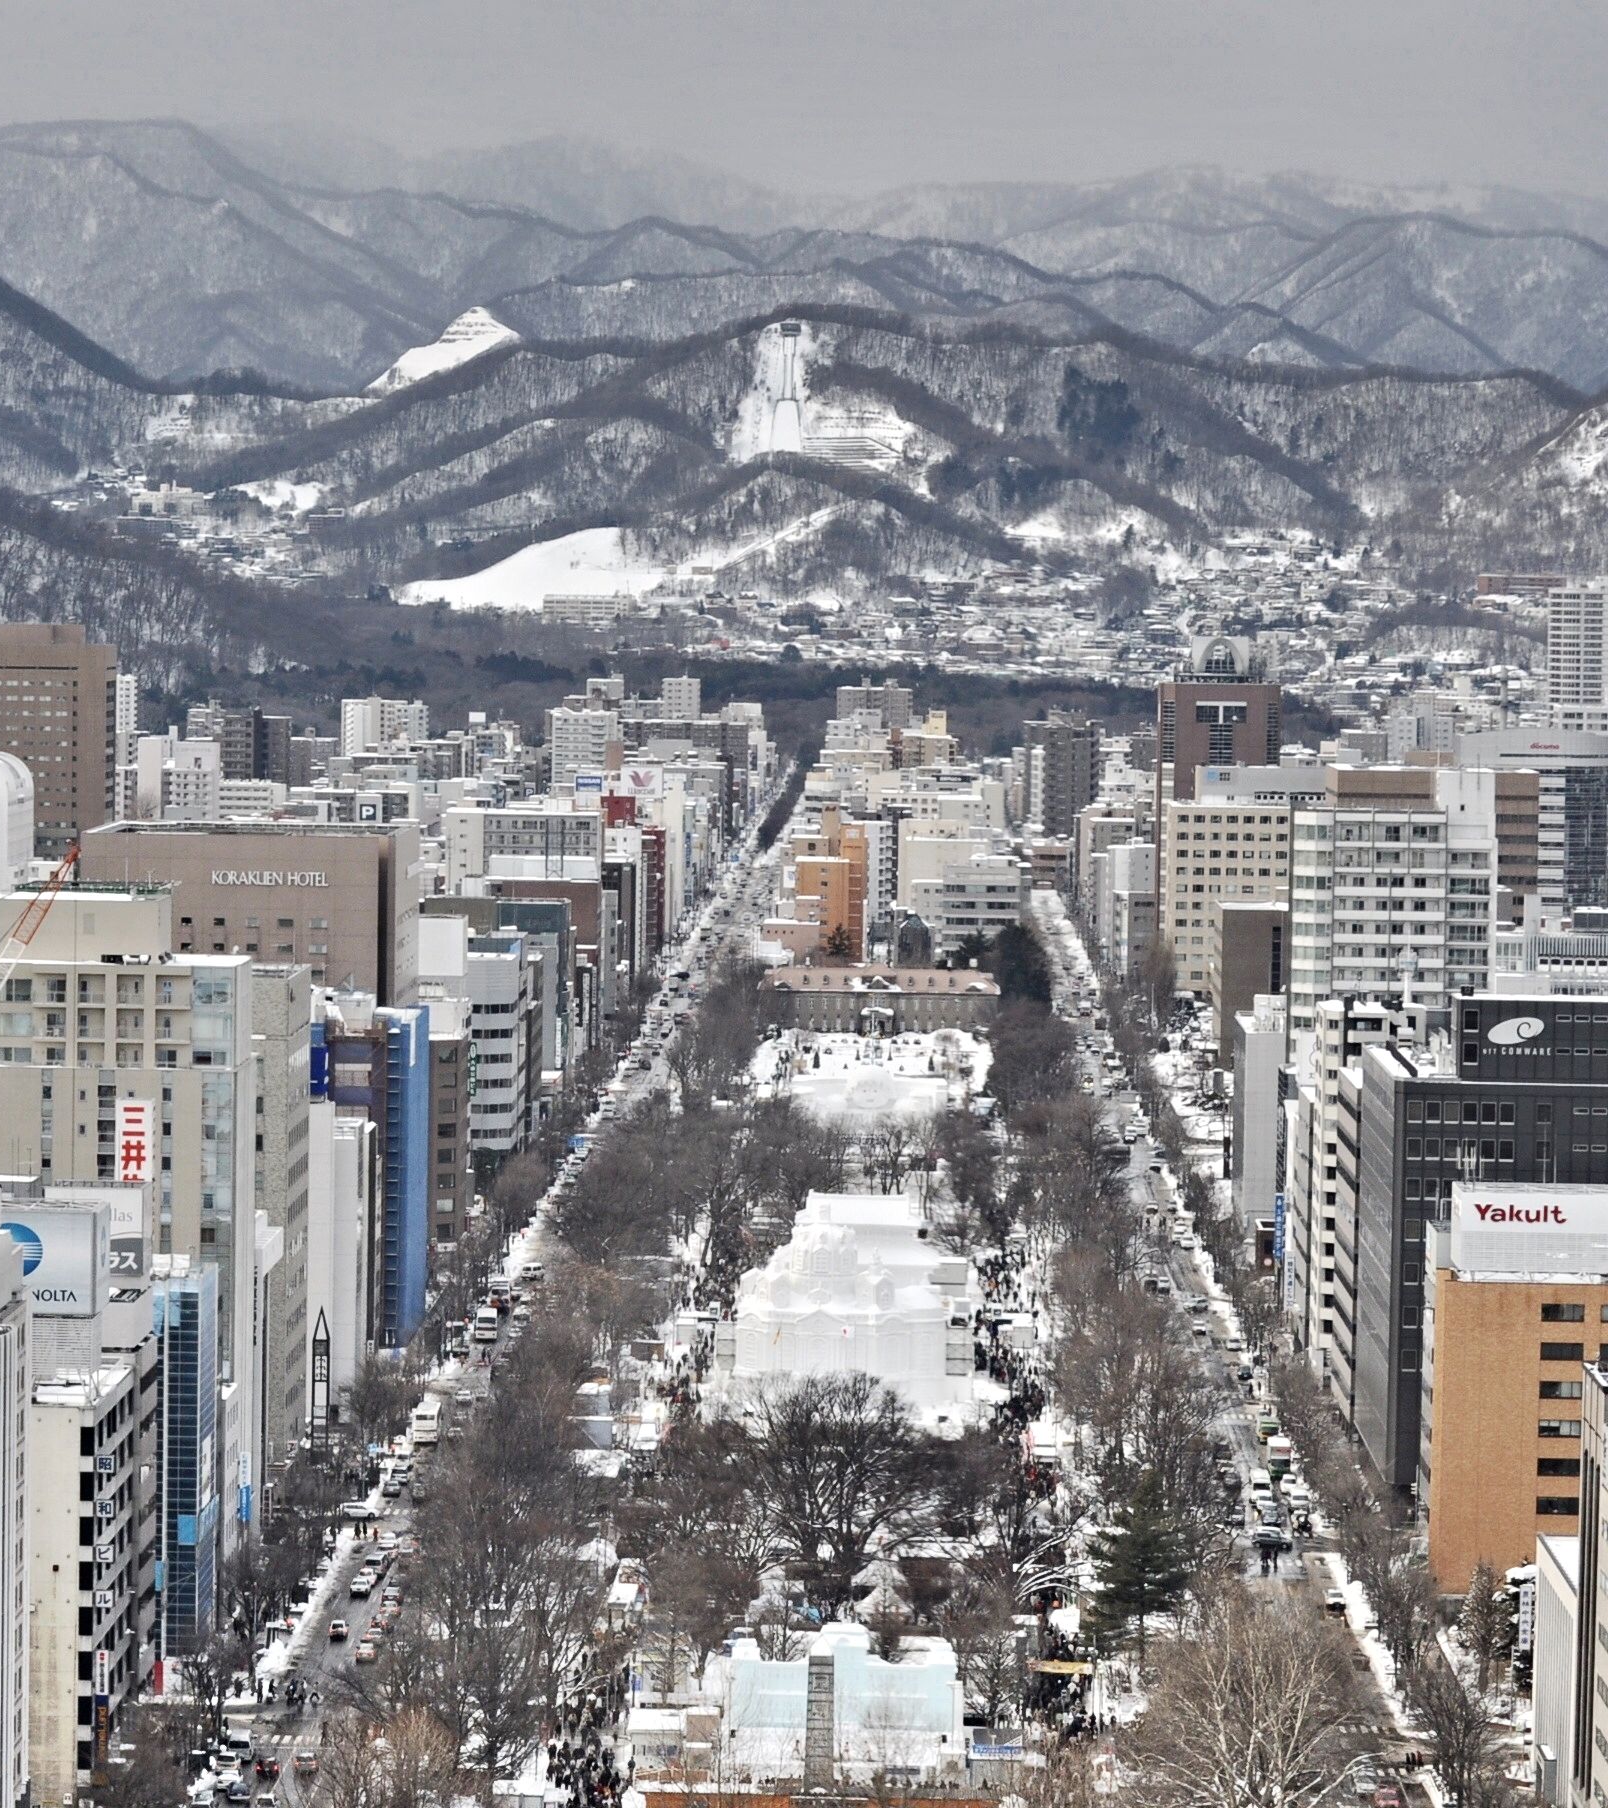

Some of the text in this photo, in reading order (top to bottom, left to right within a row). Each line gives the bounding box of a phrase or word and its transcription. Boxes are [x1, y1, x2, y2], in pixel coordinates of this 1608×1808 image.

[360, 803, 376, 819] P
[212, 871, 328, 887] KORAKUEN HOTEL
[1501, 1047, 1551, 1056] COMWARE
[121, 1106, 146, 1182] 三井
[1475, 1204, 1567, 1224] Yakult
